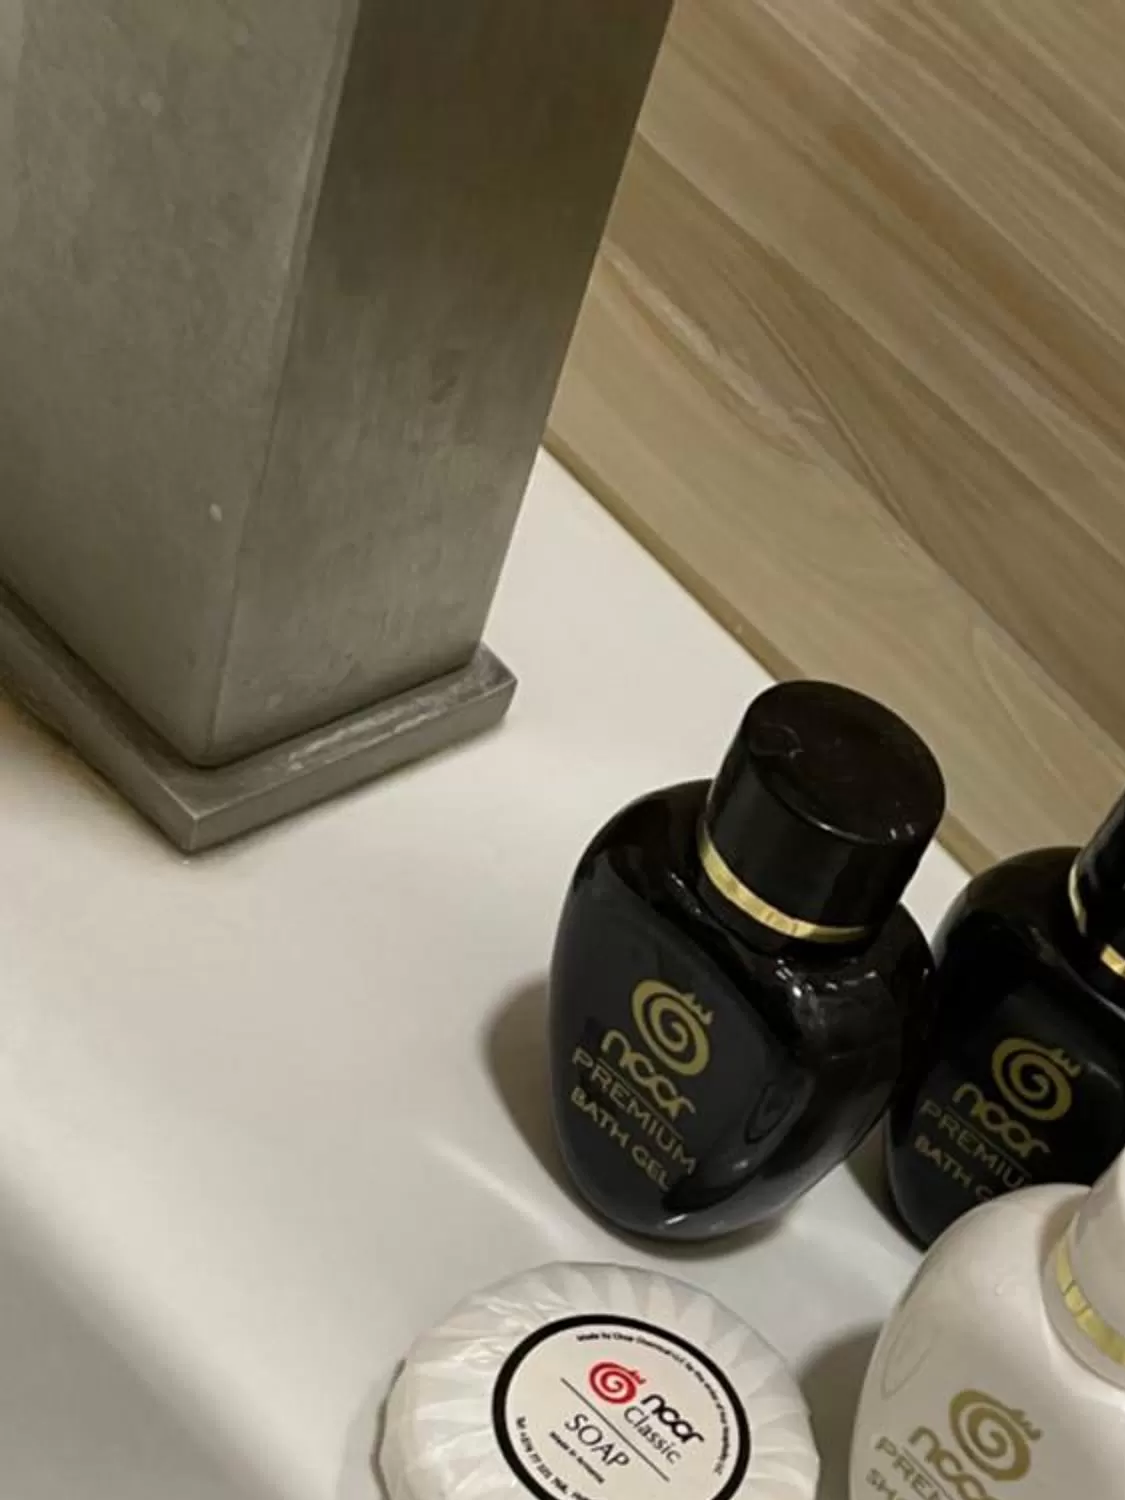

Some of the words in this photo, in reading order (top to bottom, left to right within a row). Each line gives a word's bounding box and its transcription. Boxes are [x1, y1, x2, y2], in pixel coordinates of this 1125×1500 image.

[571, 1046, 697, 1175] PREMIUM
[601, 1029, 696, 1121] noor
[570, 1086, 631, 1149] BATH
[631, 1144, 671, 1192] GEL
[919, 1100, 1026, 1188] PREMIU
[952, 1082, 1051, 1158] noor
[914, 1135, 973, 1189] BATH
[564, 1413, 631, 1468] SOAP
[623, 1406, 682, 1465] Classic
[640, 1393, 705, 1445] noor
